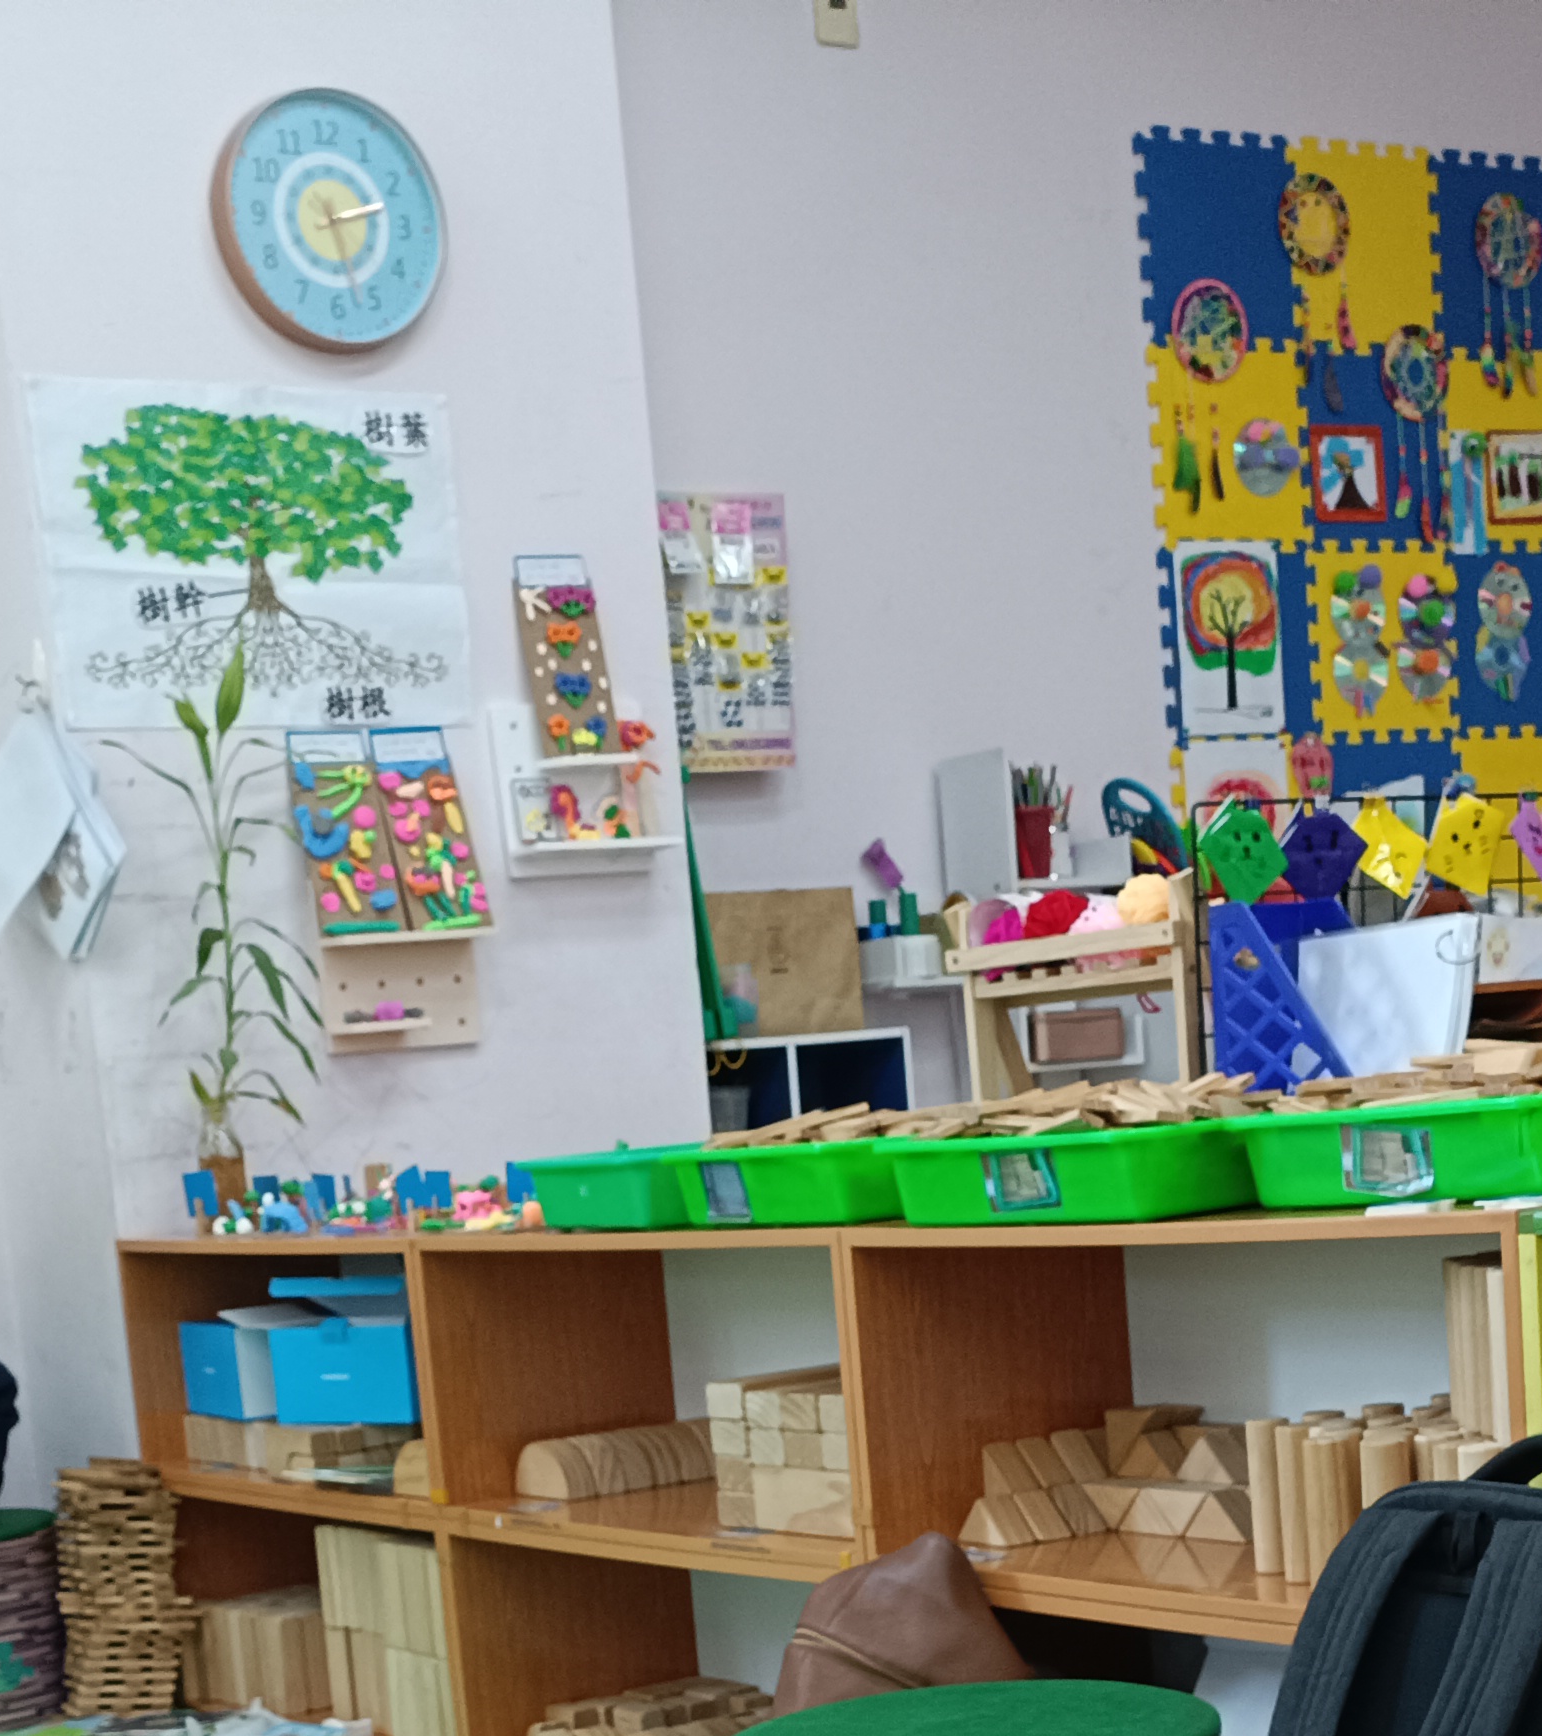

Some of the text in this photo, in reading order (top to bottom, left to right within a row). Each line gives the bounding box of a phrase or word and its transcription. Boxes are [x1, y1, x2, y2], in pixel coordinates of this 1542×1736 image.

[275, 129, 301, 155] 11
[311, 119, 339, 146] 12
[358, 139, 371, 163] 1
[252, 157, 280, 183] 10
[385, 170, 401, 197] 2
[250, 200, 266, 226] 9
[398, 215, 412, 240] 3
[263, 244, 279, 269] 8
[391, 257, 405, 279] 4
[294, 279, 309, 304] 7
[367, 285, 382, 311] 5
[330, 294, 346, 320] 6
[364, 410, 428, 447] 樹葉
[138, 579, 207, 624] 樹幹
[326, 686, 391, 721] 樹根
